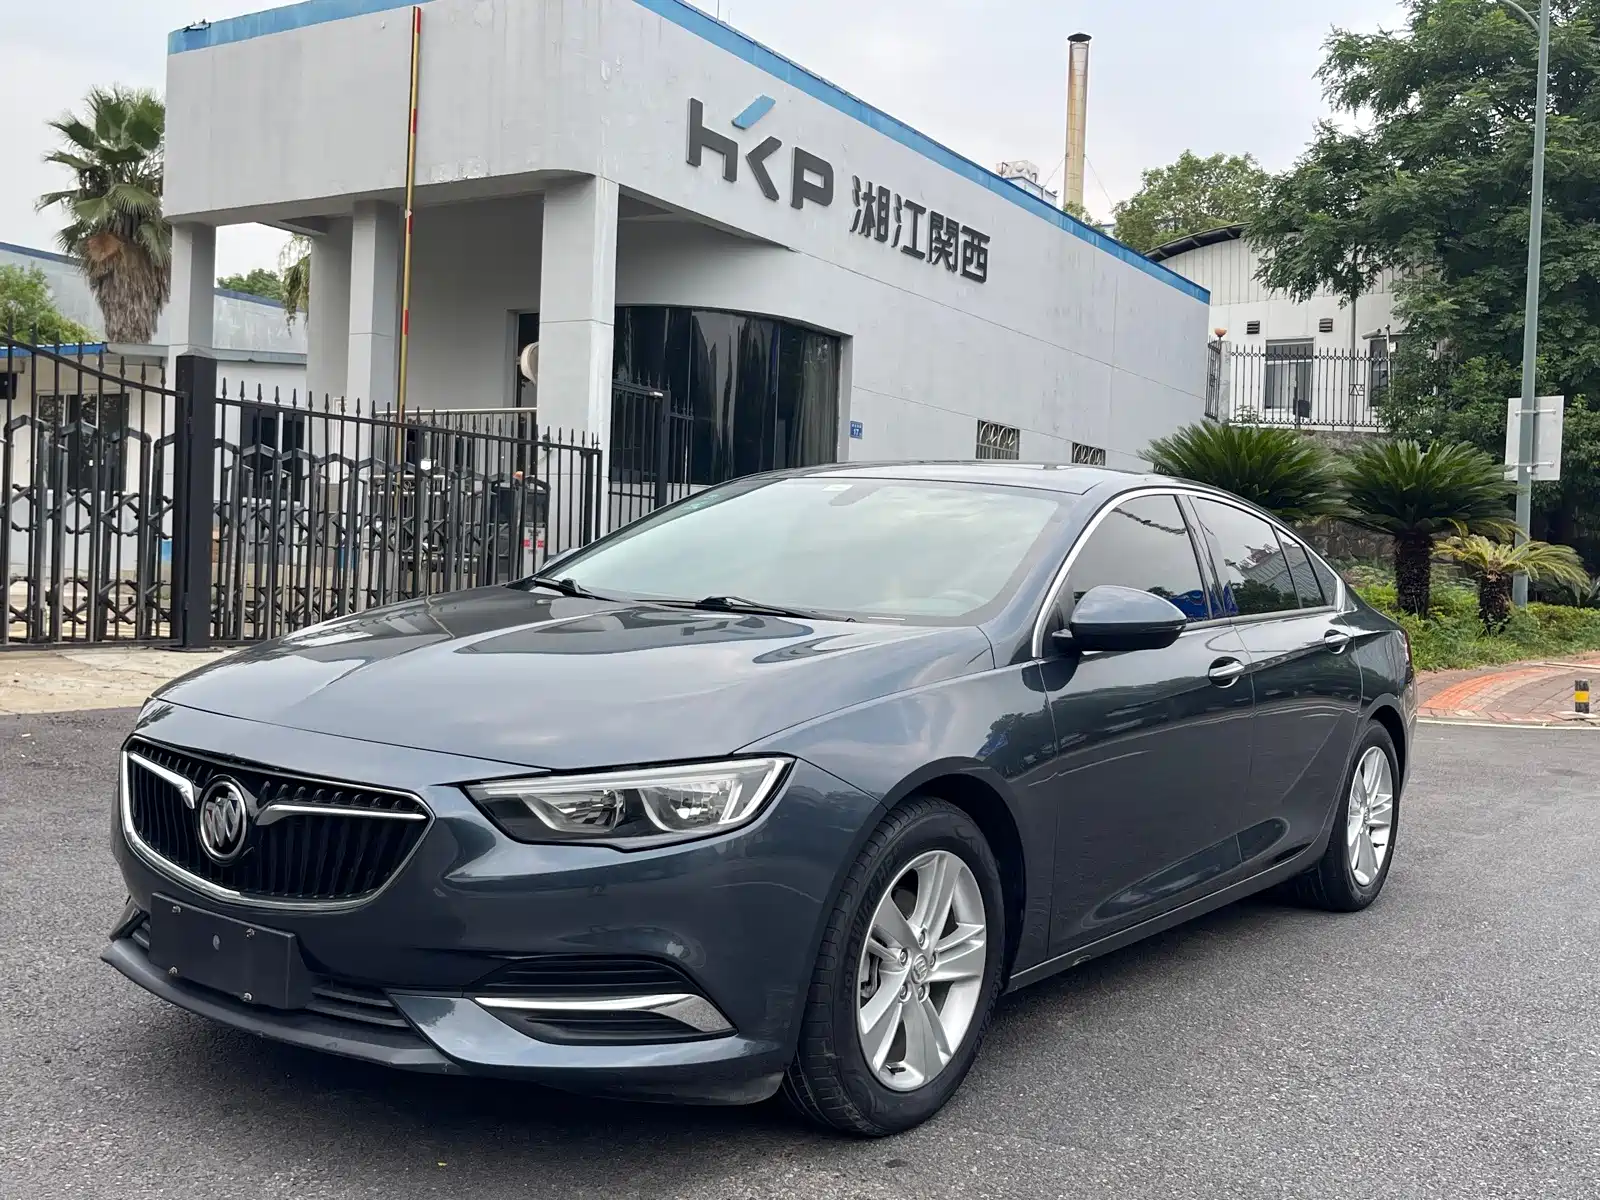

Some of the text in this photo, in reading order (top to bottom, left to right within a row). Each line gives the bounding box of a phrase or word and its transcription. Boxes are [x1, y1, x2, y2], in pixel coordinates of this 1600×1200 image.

[687, 94, 834, 209] HKP
[849, 175, 990, 283] 湘江関西
